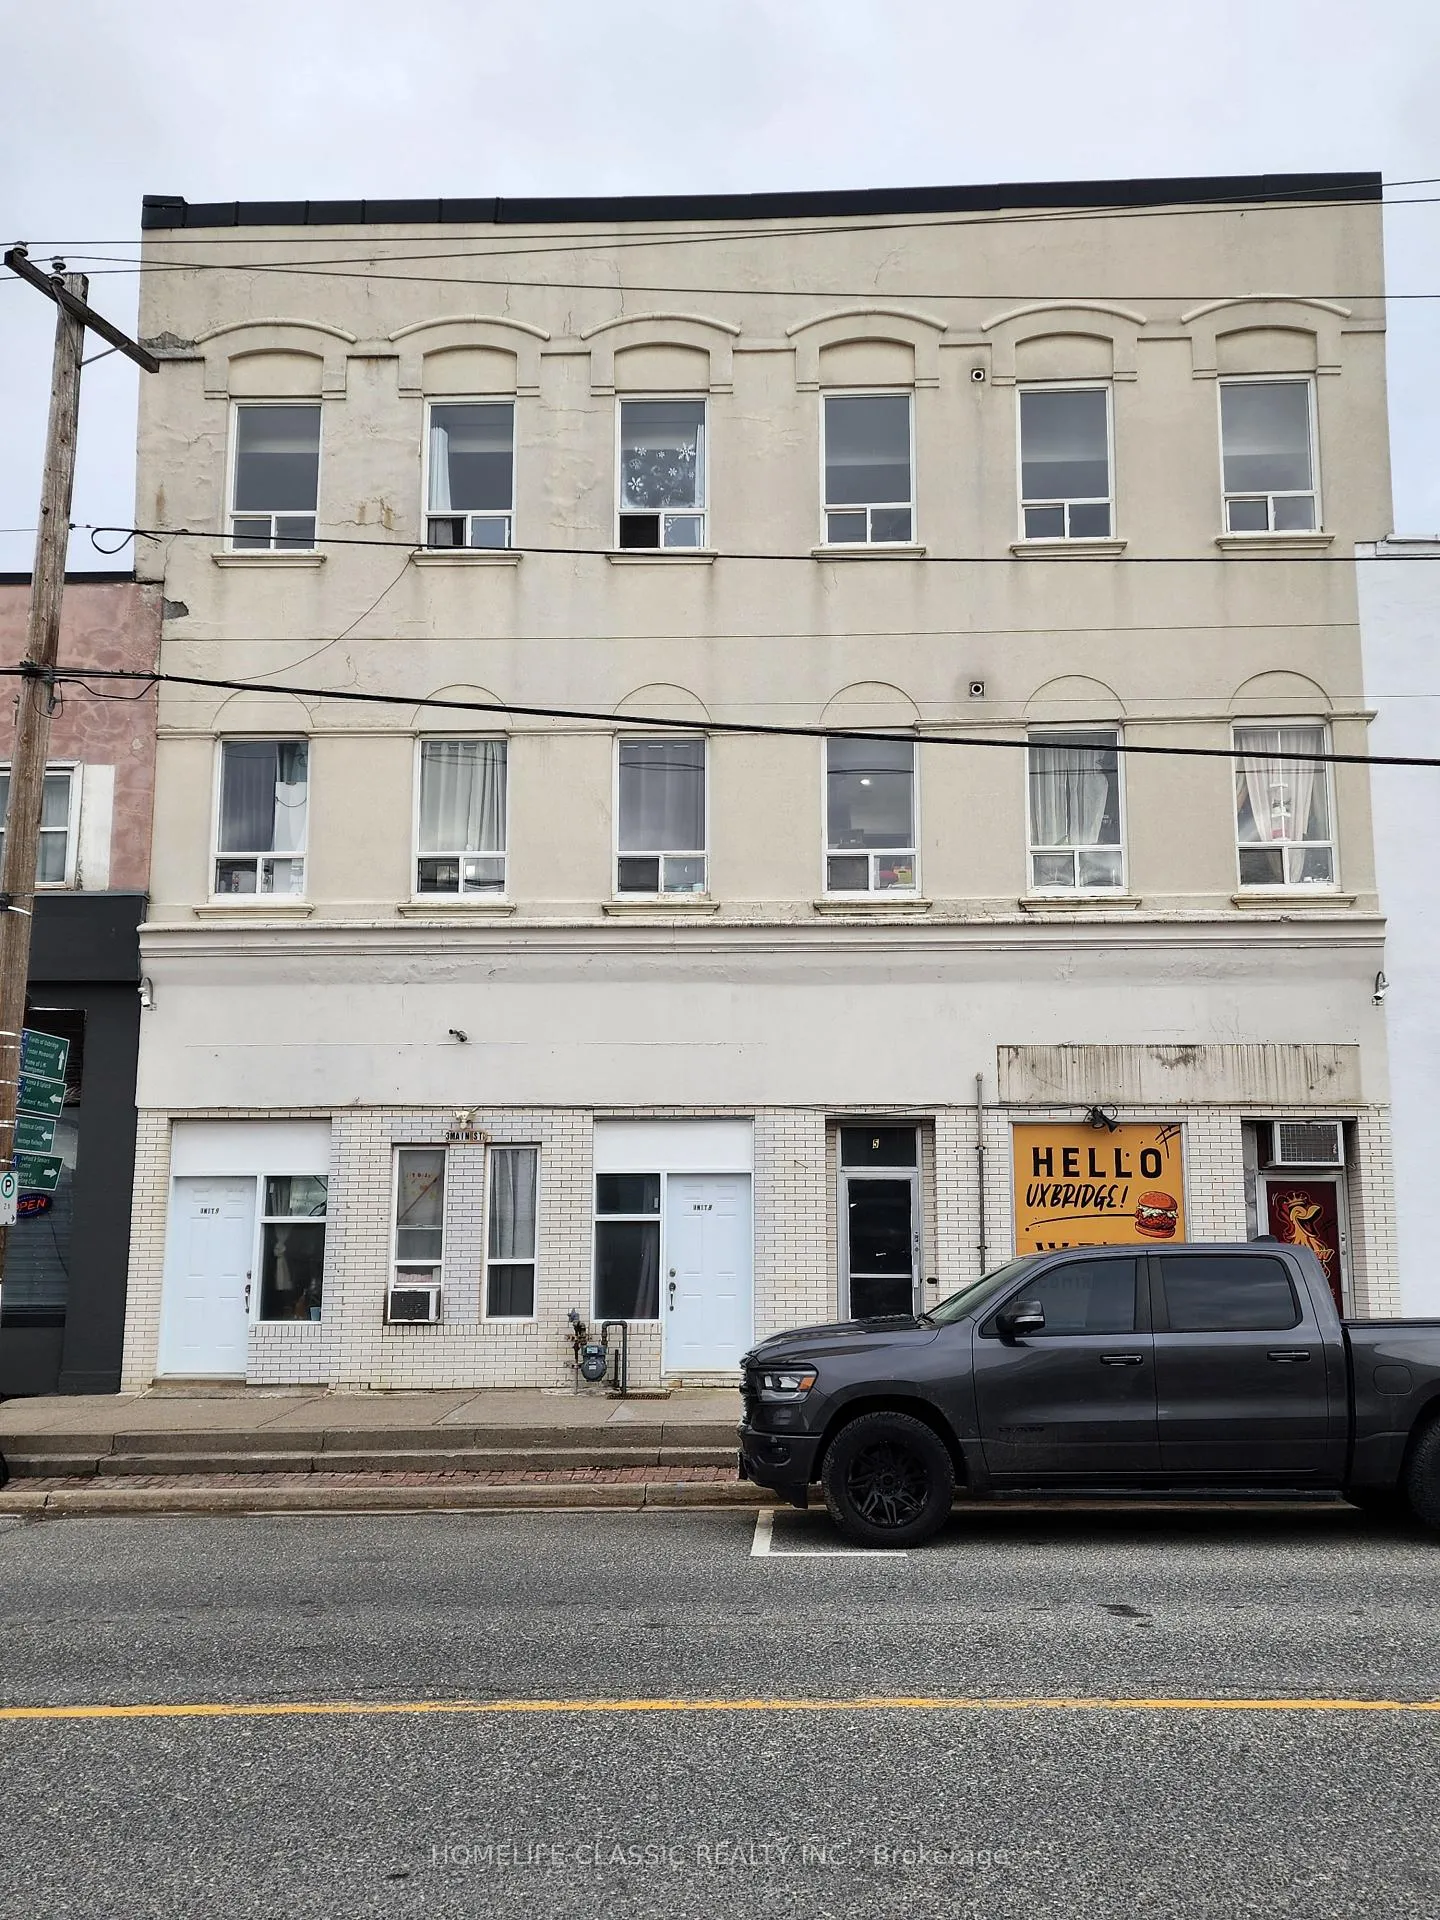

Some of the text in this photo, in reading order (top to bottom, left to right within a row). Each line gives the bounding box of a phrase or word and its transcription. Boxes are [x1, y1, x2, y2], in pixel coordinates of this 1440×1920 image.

[872, 1138, 880, 1149] 5
[1031, 1146, 1163, 1179] HELLO
[1026, 1183, 1129, 1211] UXBRIDGE!
